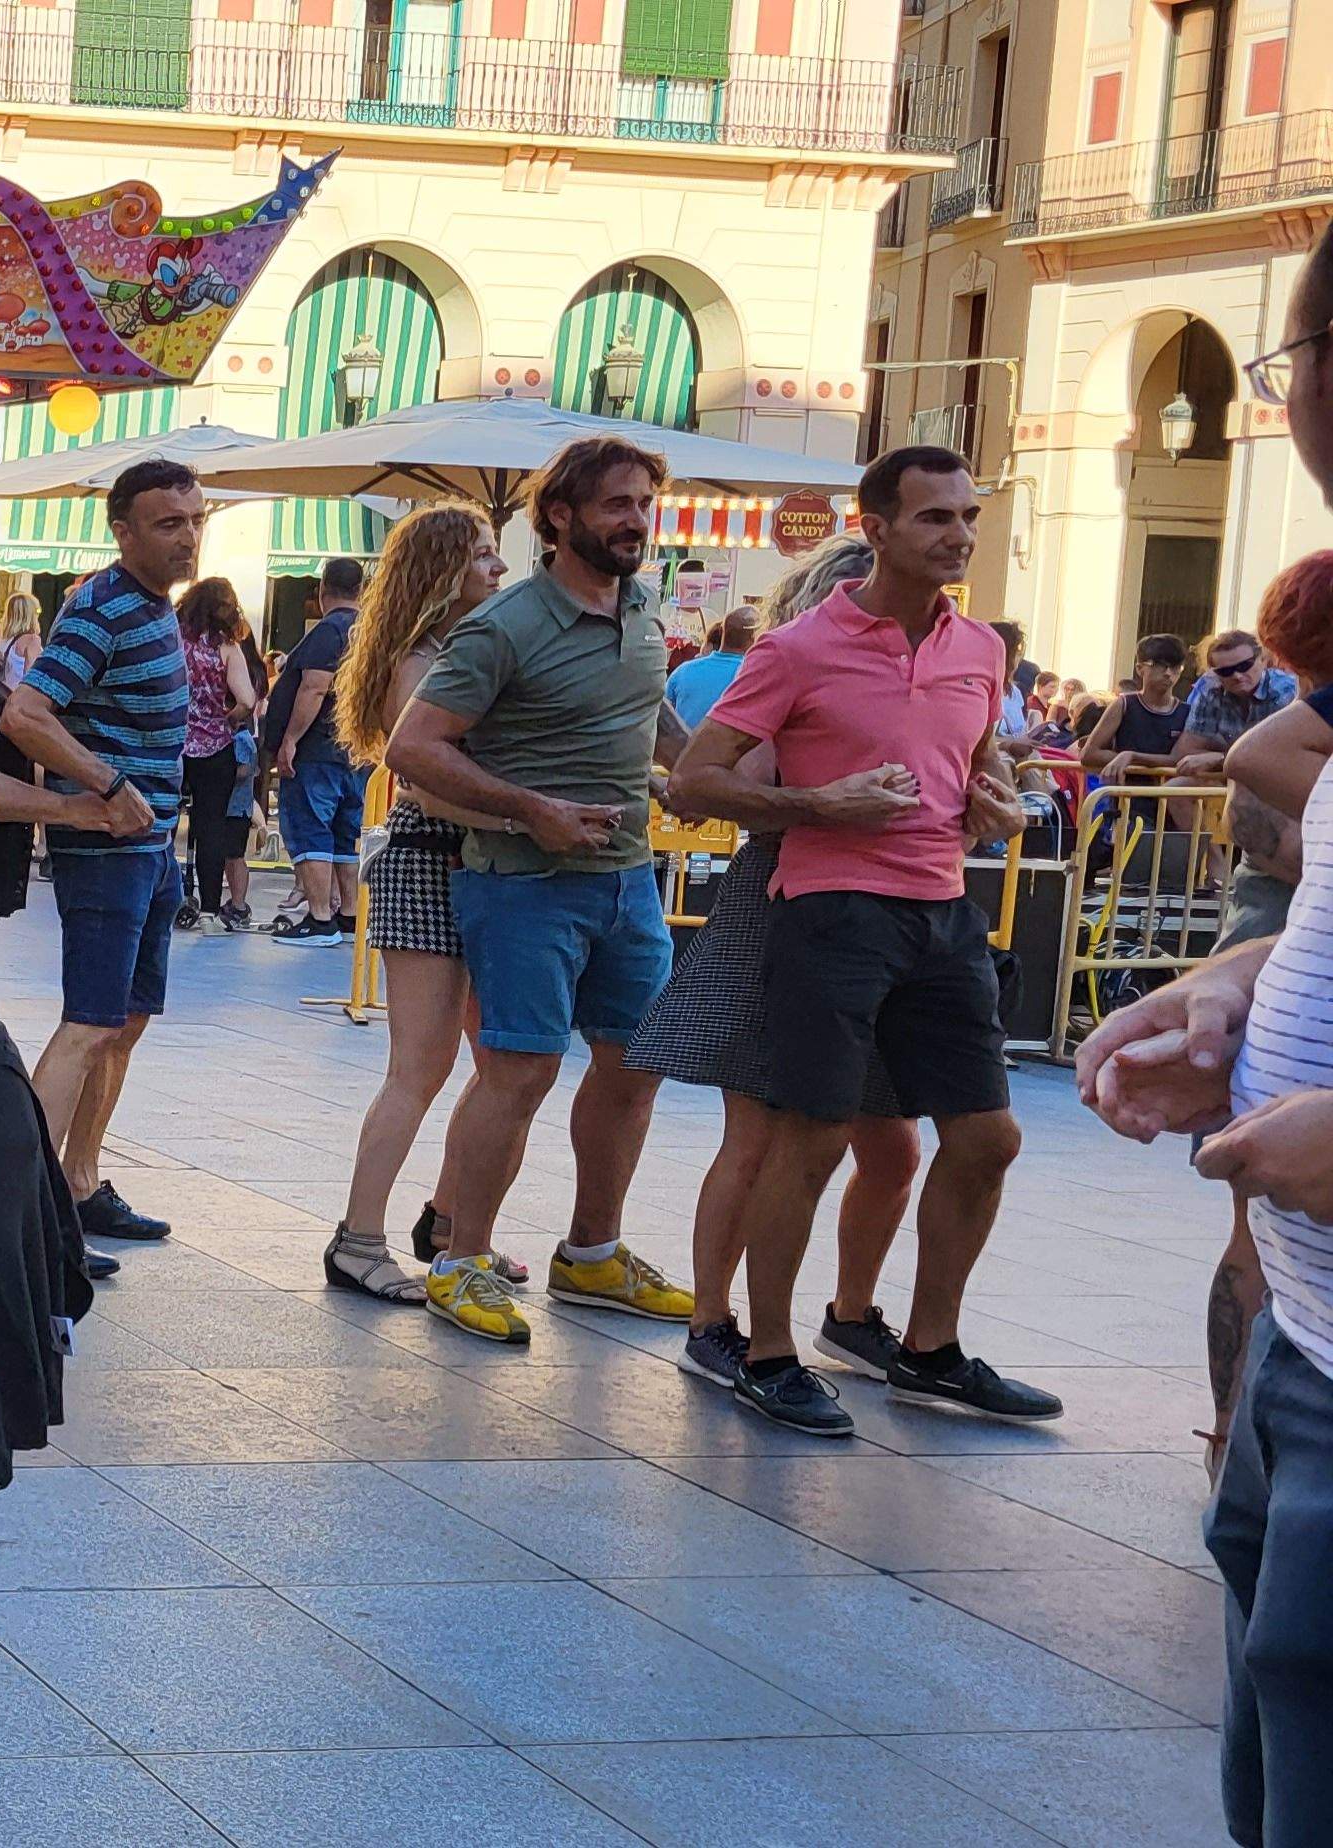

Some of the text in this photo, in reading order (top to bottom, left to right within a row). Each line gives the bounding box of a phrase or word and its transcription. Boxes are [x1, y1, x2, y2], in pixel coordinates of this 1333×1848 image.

[779, 511, 831, 523] COTTON
[782, 525, 826, 537] CANDY
[56, 549, 71, 570] LA
